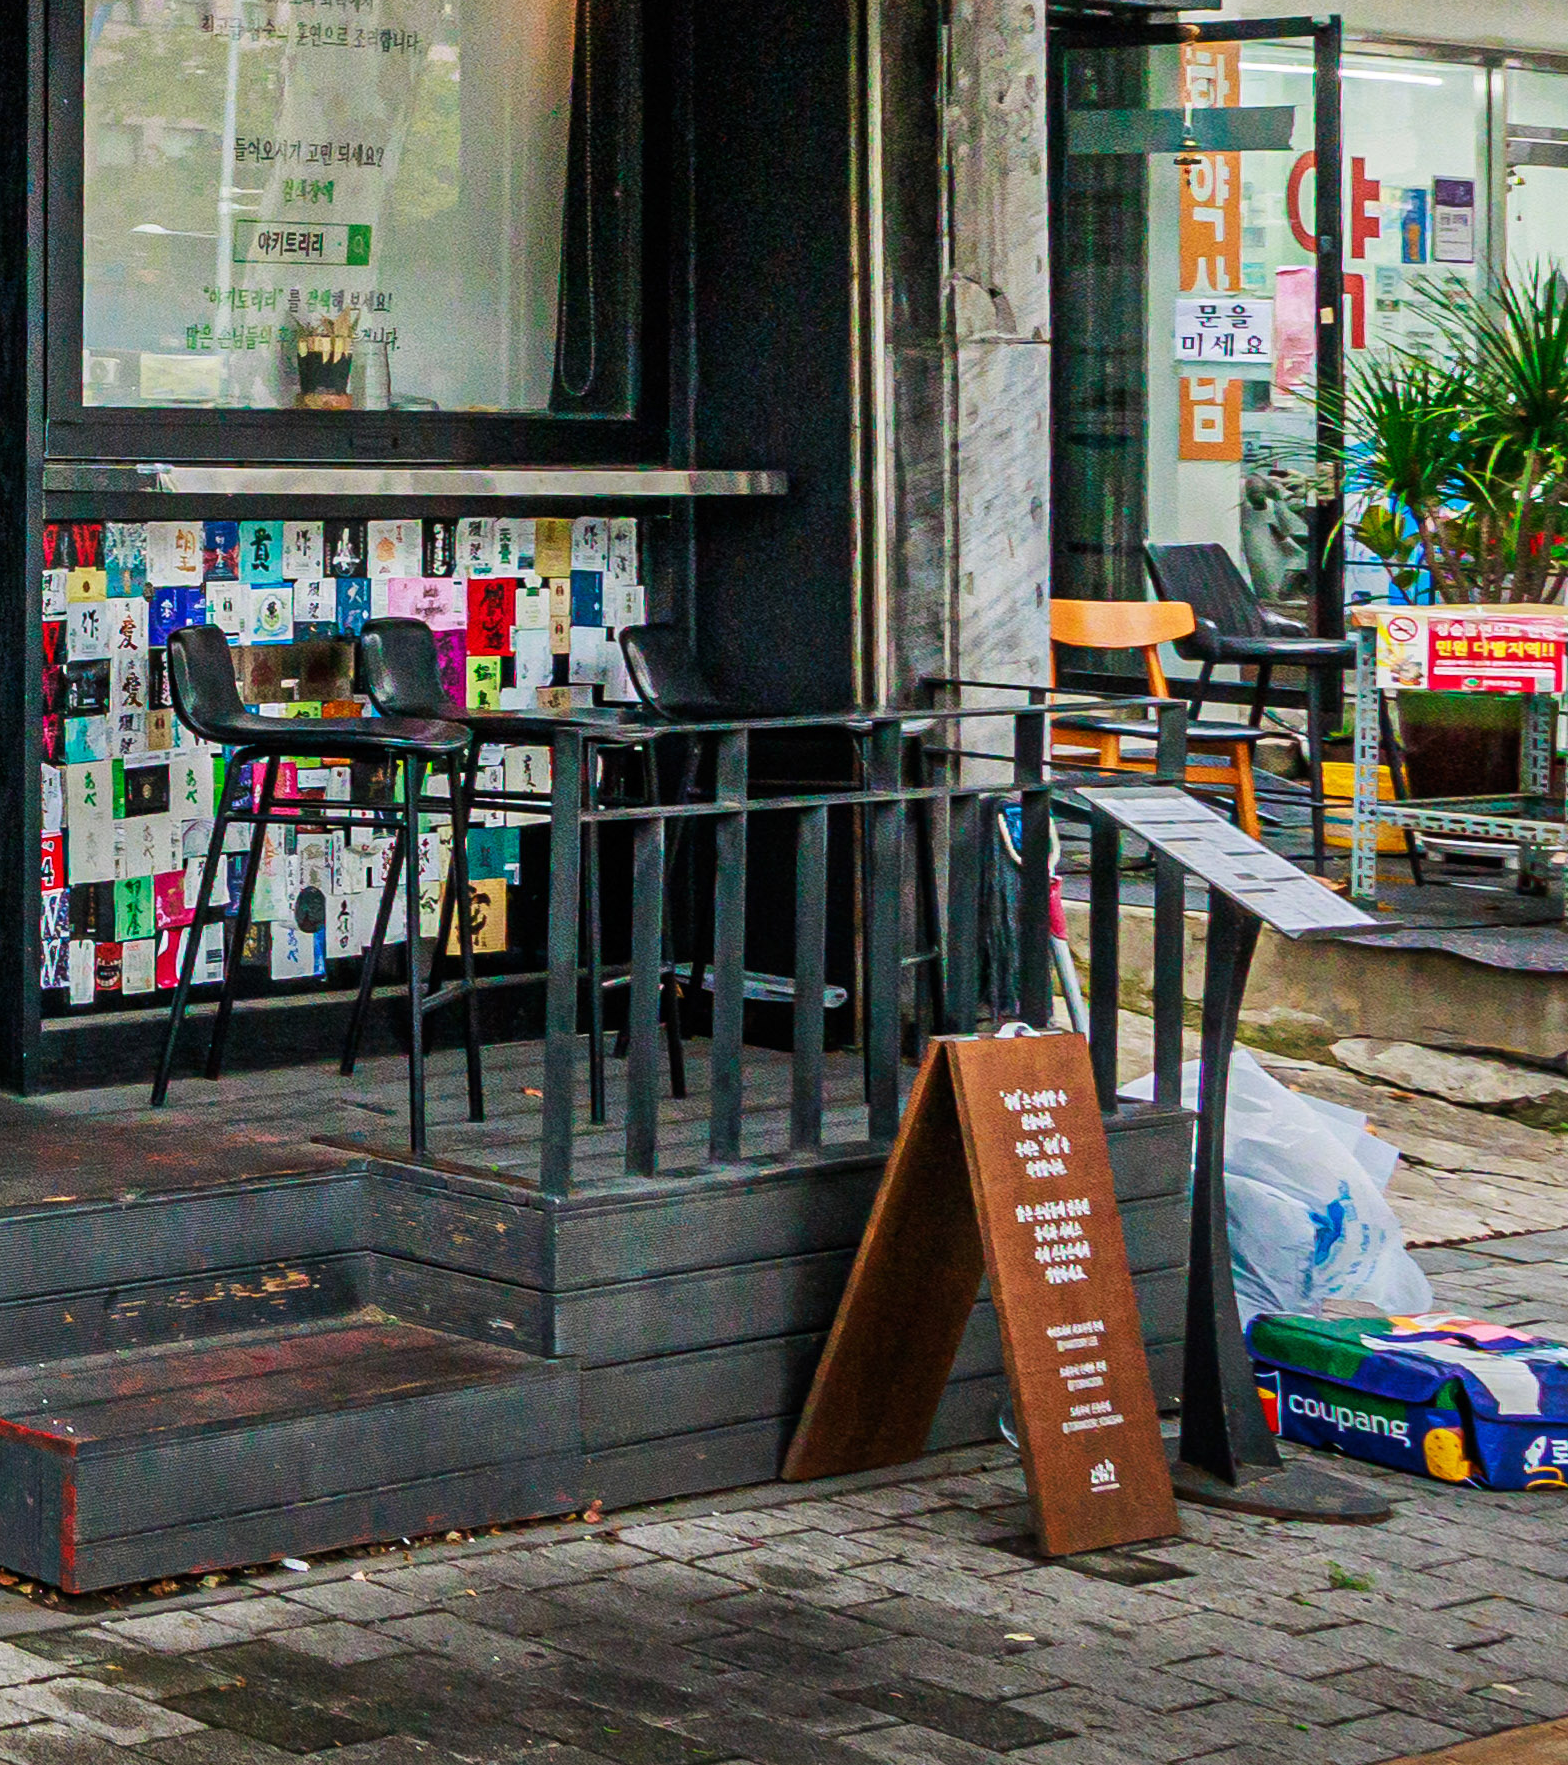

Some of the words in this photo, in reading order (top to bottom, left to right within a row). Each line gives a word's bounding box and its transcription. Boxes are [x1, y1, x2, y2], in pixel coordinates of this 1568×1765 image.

[234, 137, 301, 164] 들어오시기
[1194, 304, 1254, 329] 문을
[1181, 333, 1268, 358] 미세요
[1289, 1394, 1412, 1448] coupang
